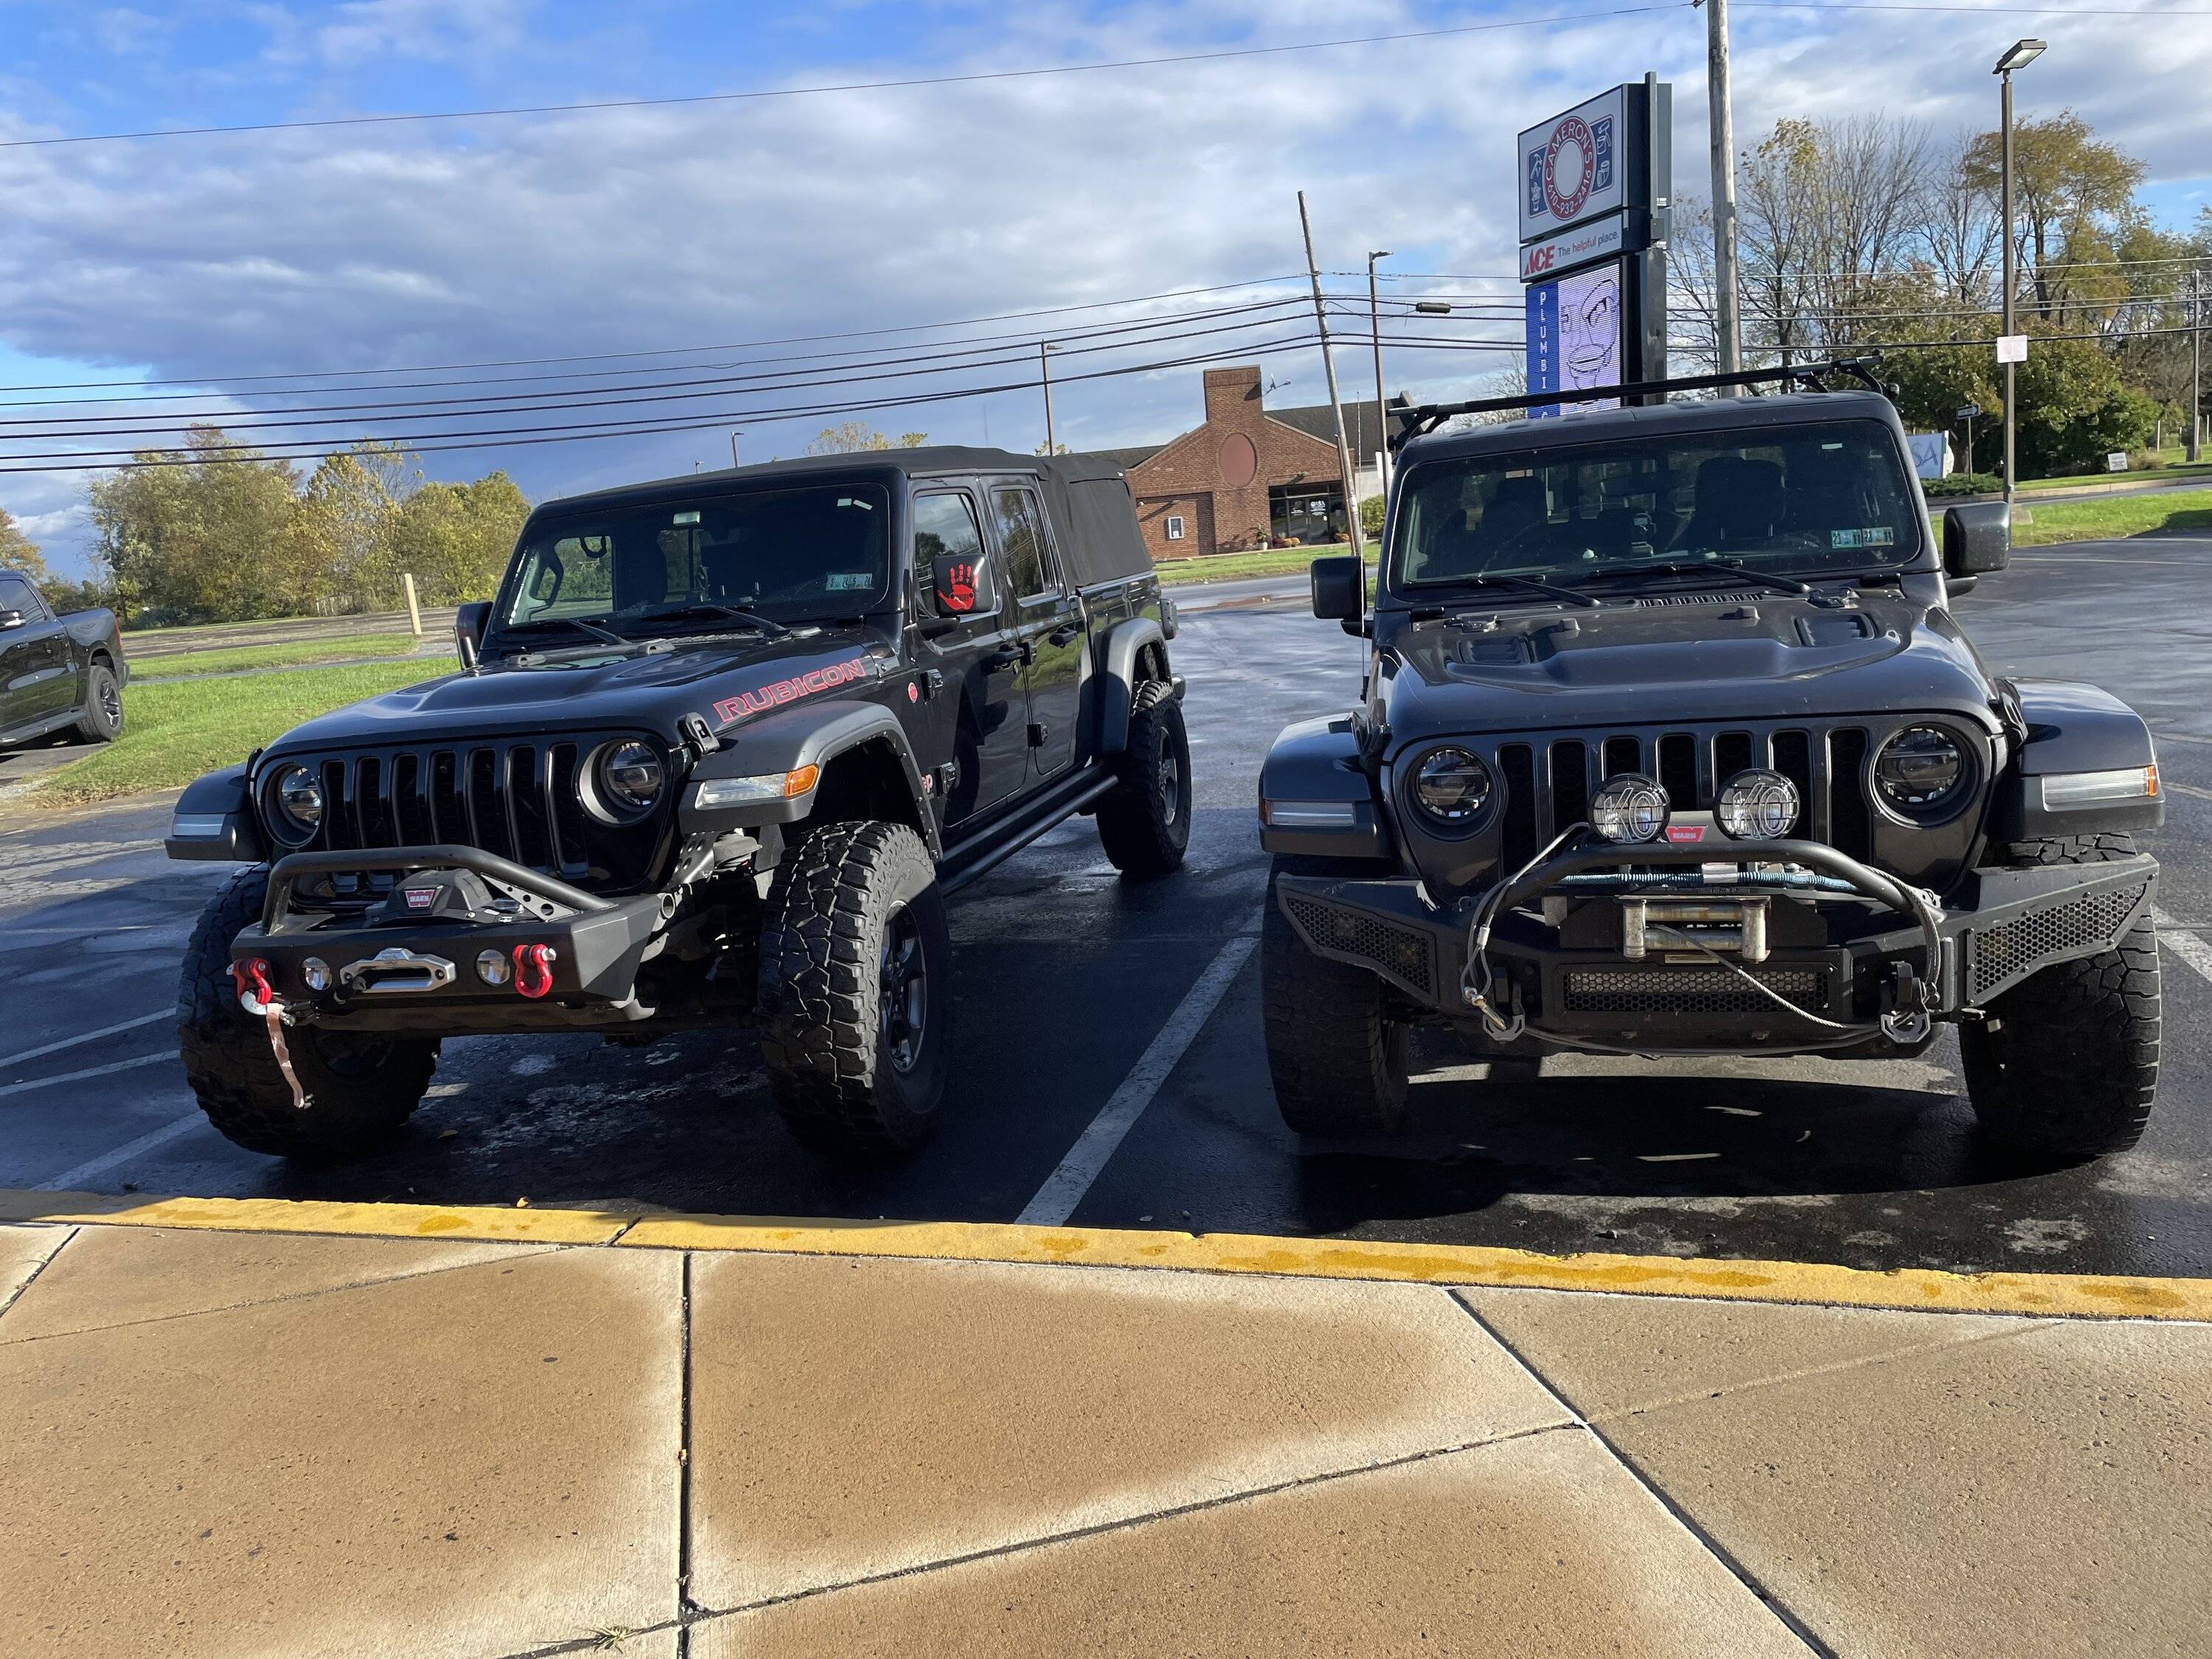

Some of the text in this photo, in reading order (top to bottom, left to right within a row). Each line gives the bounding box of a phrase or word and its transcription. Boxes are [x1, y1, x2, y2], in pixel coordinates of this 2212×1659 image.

[1545, 122, 1593, 181] CAMERON'S
[1548, 170, 1592, 215] 610-932-2416
[1524, 245, 1555, 276] ACE
[1558, 247, 1571, 257] The
[1573, 235, 1596, 252] helpful
[713, 659, 866, 722] RUBICON
